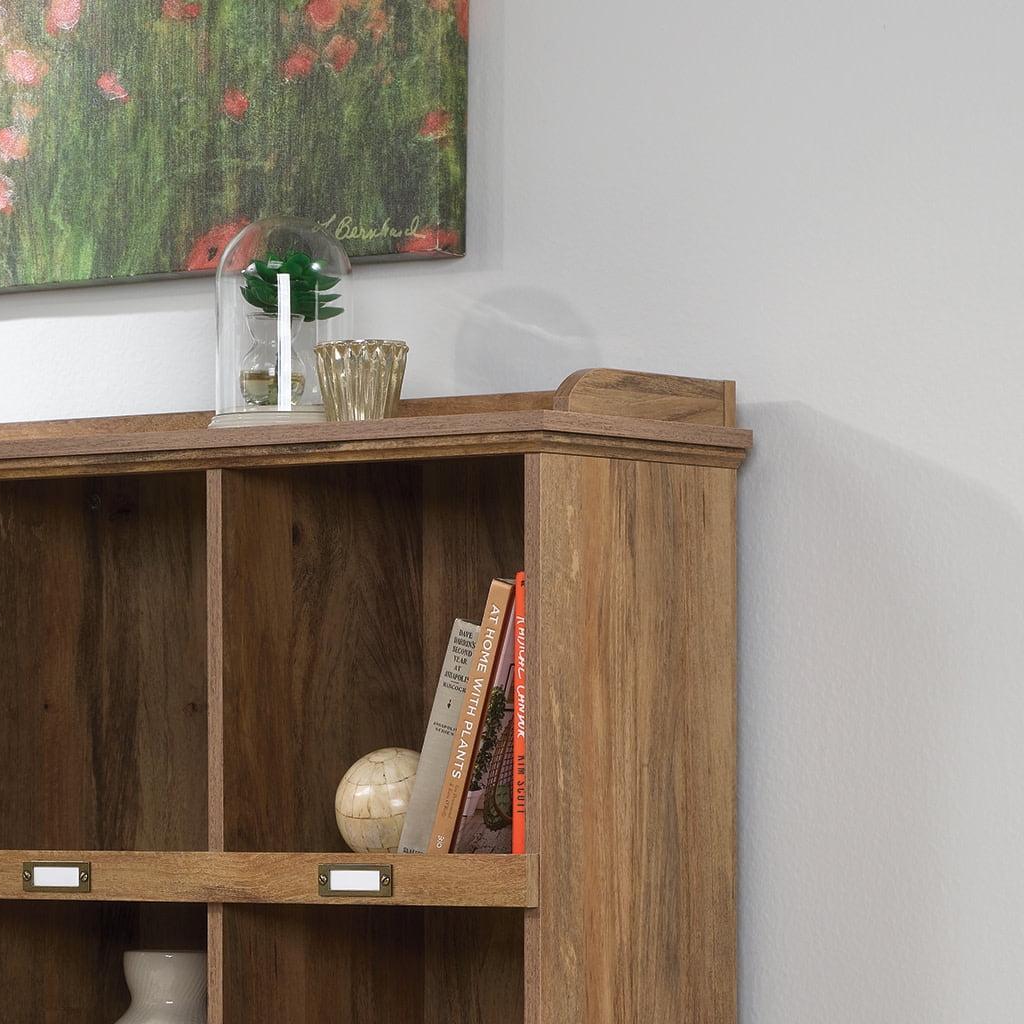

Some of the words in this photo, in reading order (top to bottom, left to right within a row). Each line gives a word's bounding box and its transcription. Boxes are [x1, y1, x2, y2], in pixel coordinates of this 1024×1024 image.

[491, 604, 500, 624] AT
[458, 628, 474, 640] DAVE
[452, 646, 473, 658] SECOND
[453, 655, 468, 666] YEAR
[477, 628, 496, 673] HOME
[466, 678, 484, 717] WITH
[451, 720, 473, 779] PLANTS
